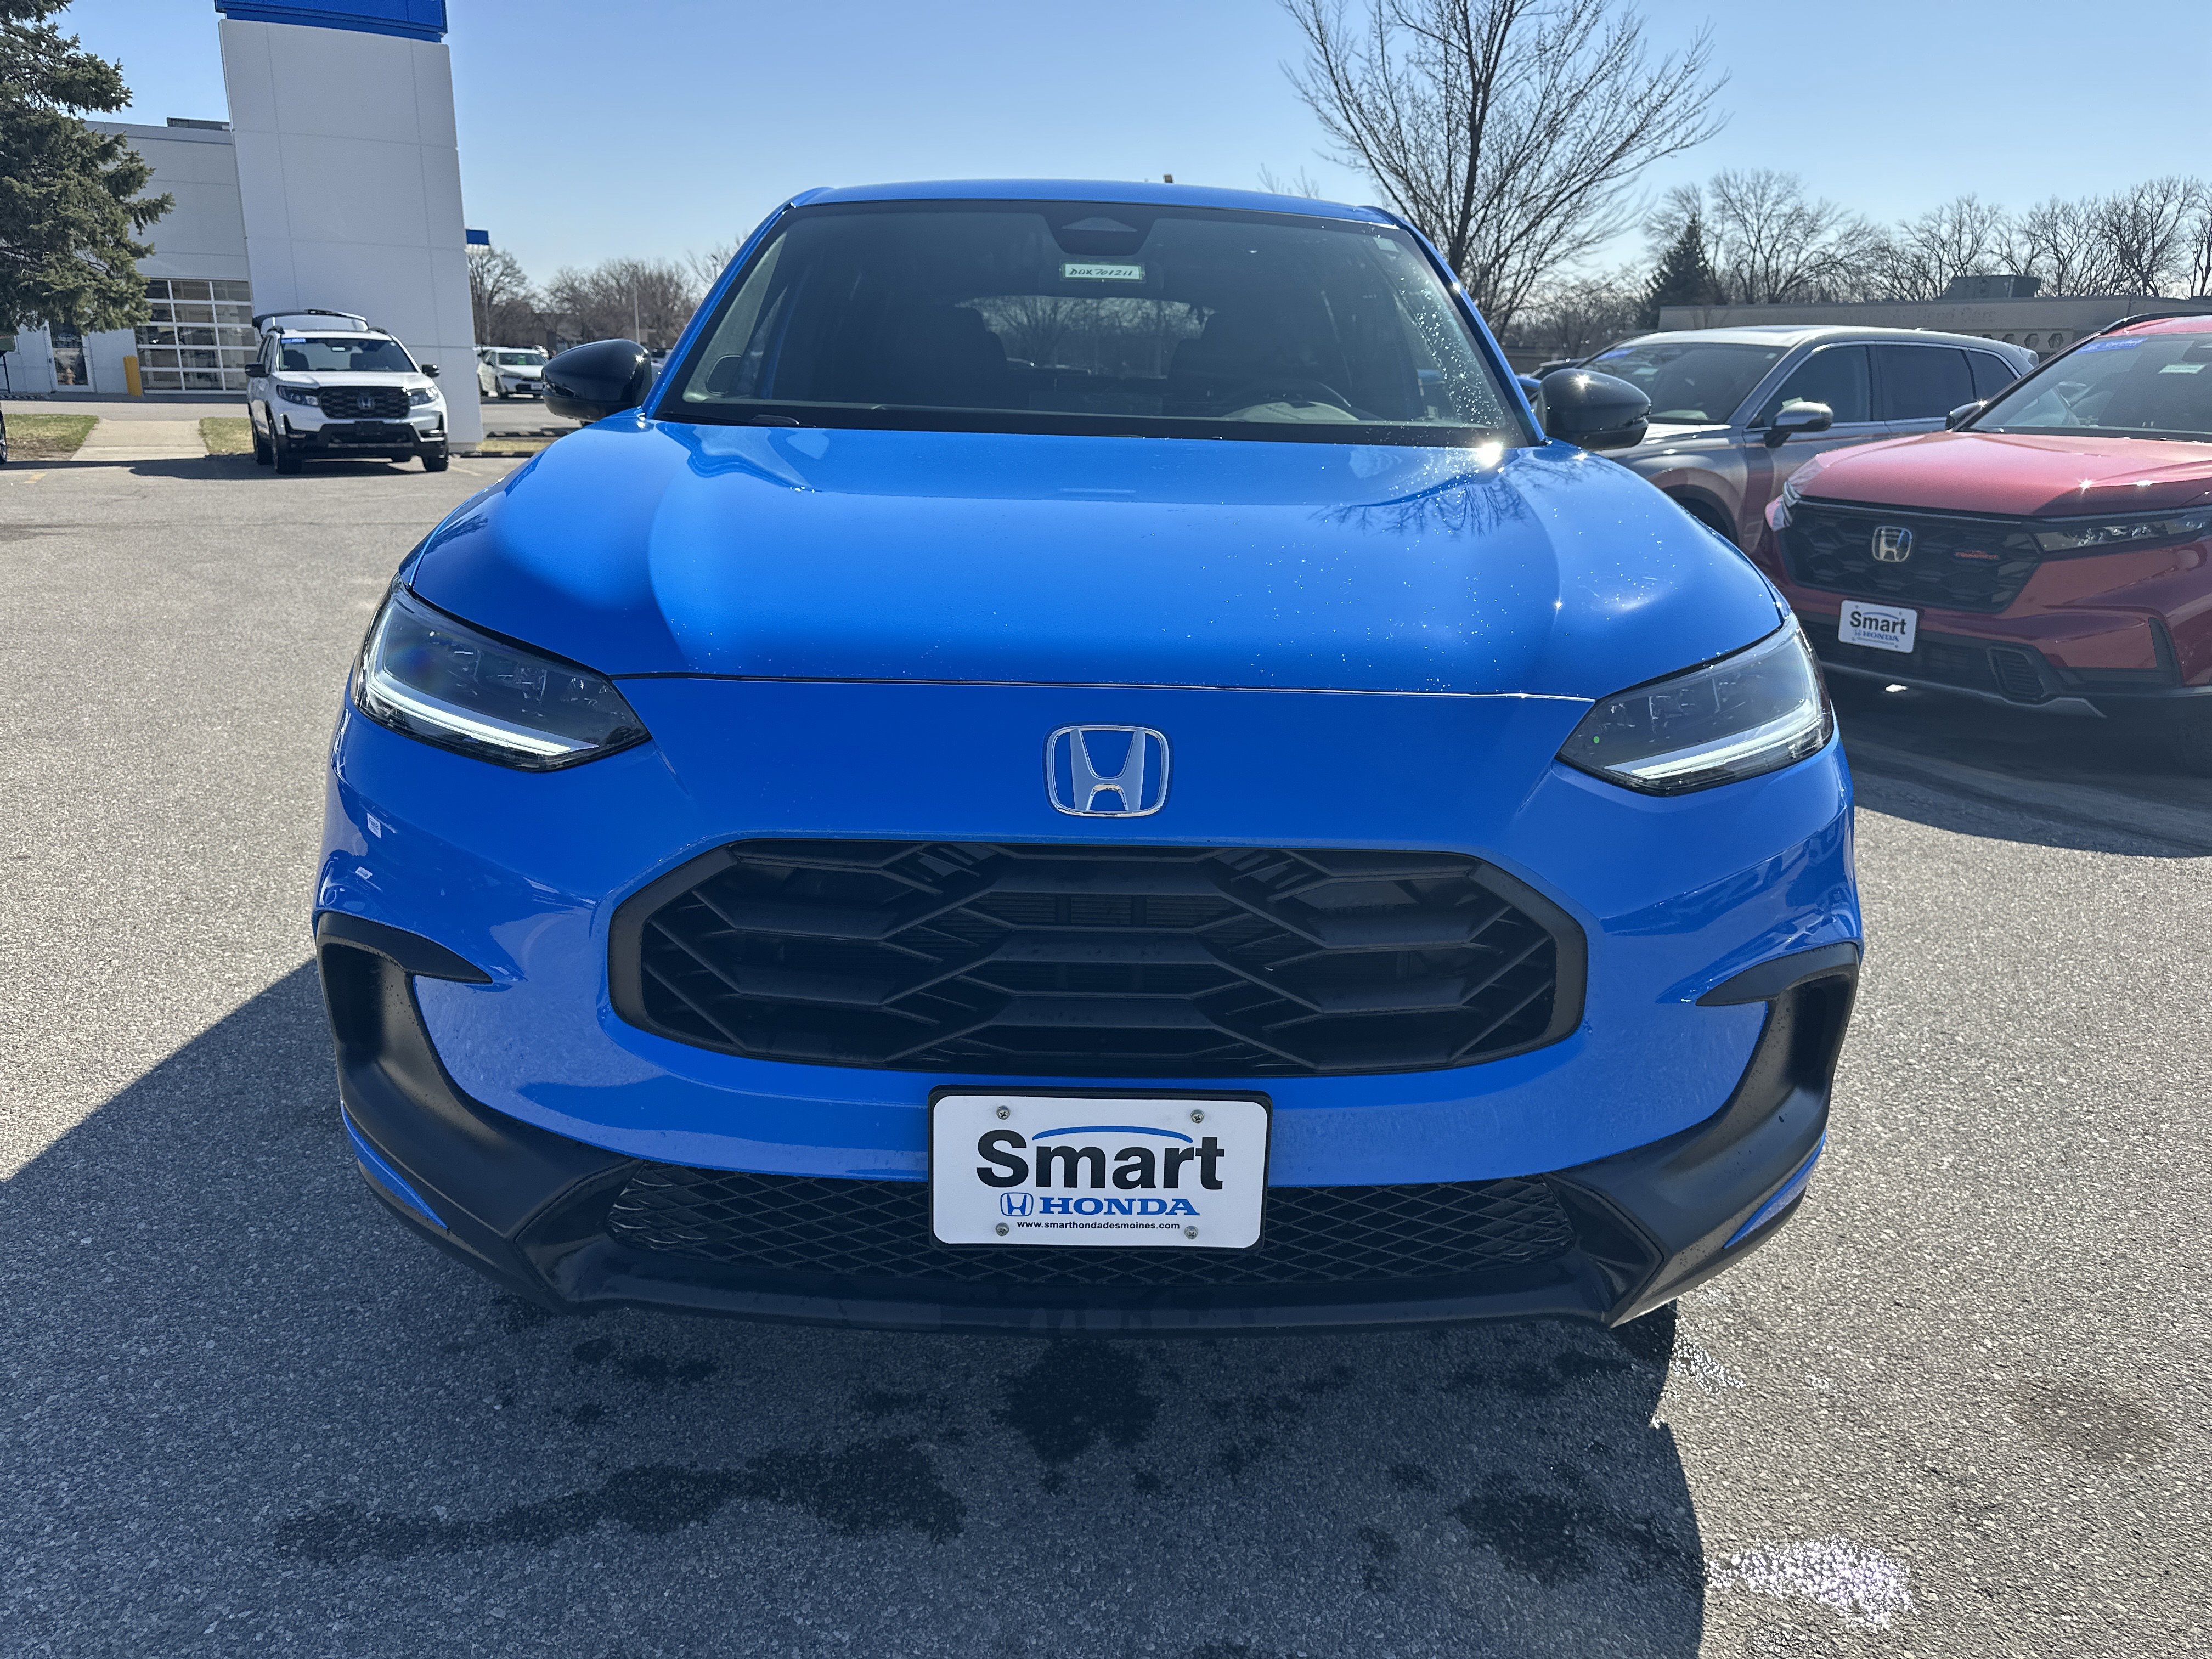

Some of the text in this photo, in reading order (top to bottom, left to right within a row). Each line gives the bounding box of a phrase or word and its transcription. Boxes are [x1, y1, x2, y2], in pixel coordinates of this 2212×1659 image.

[1850, 611, 1906, 635] Smart
[1863, 631, 1899, 642] HONDA
[976, 1129, 1225, 1190] Smart
[1039, 1197, 1200, 1216] HONDA
[1017, 1221, 1180, 1229] www.smarthondadesmoines.com
